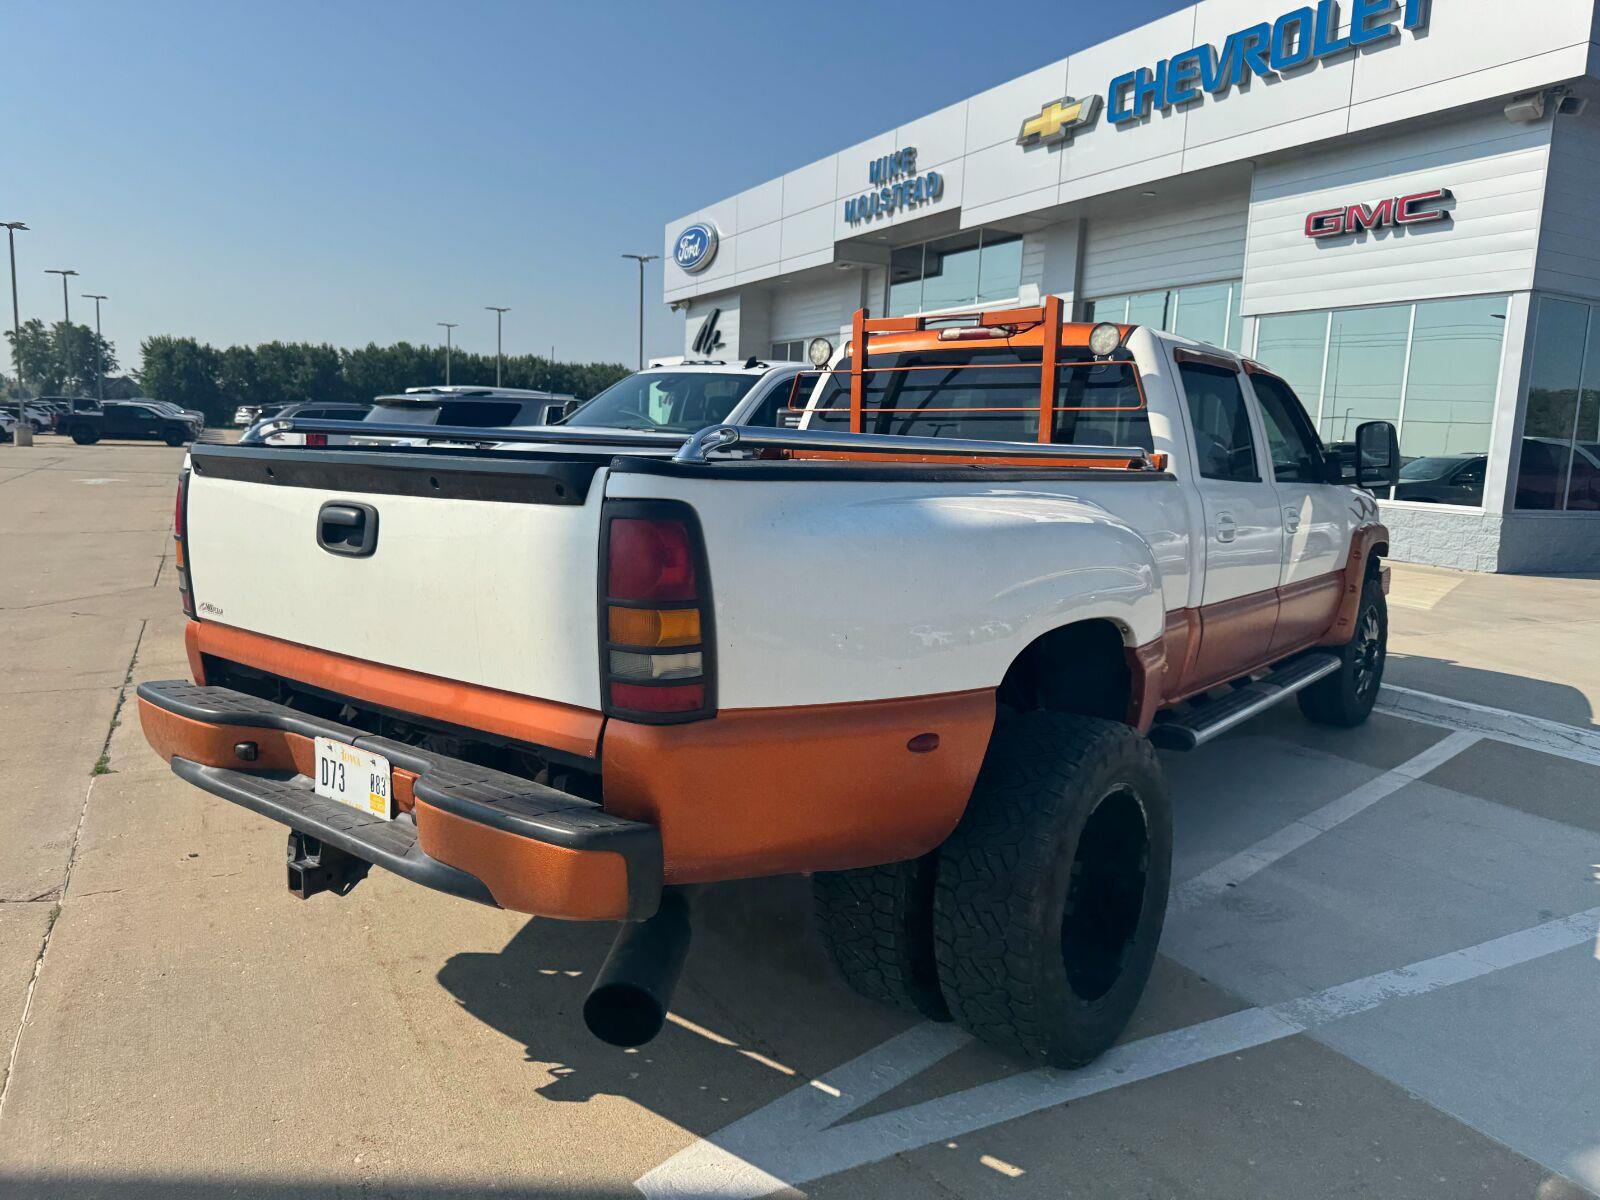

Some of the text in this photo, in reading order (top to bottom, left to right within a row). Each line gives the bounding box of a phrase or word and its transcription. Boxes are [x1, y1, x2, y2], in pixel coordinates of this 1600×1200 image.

[869, 146, 916, 185] MIKE
[845, 171, 942, 224] MOLSTEAD
[1305, 187, 1444, 238] GMC
[678, 234, 700, 261] Ford
[322, 757, 345, 792] D73
